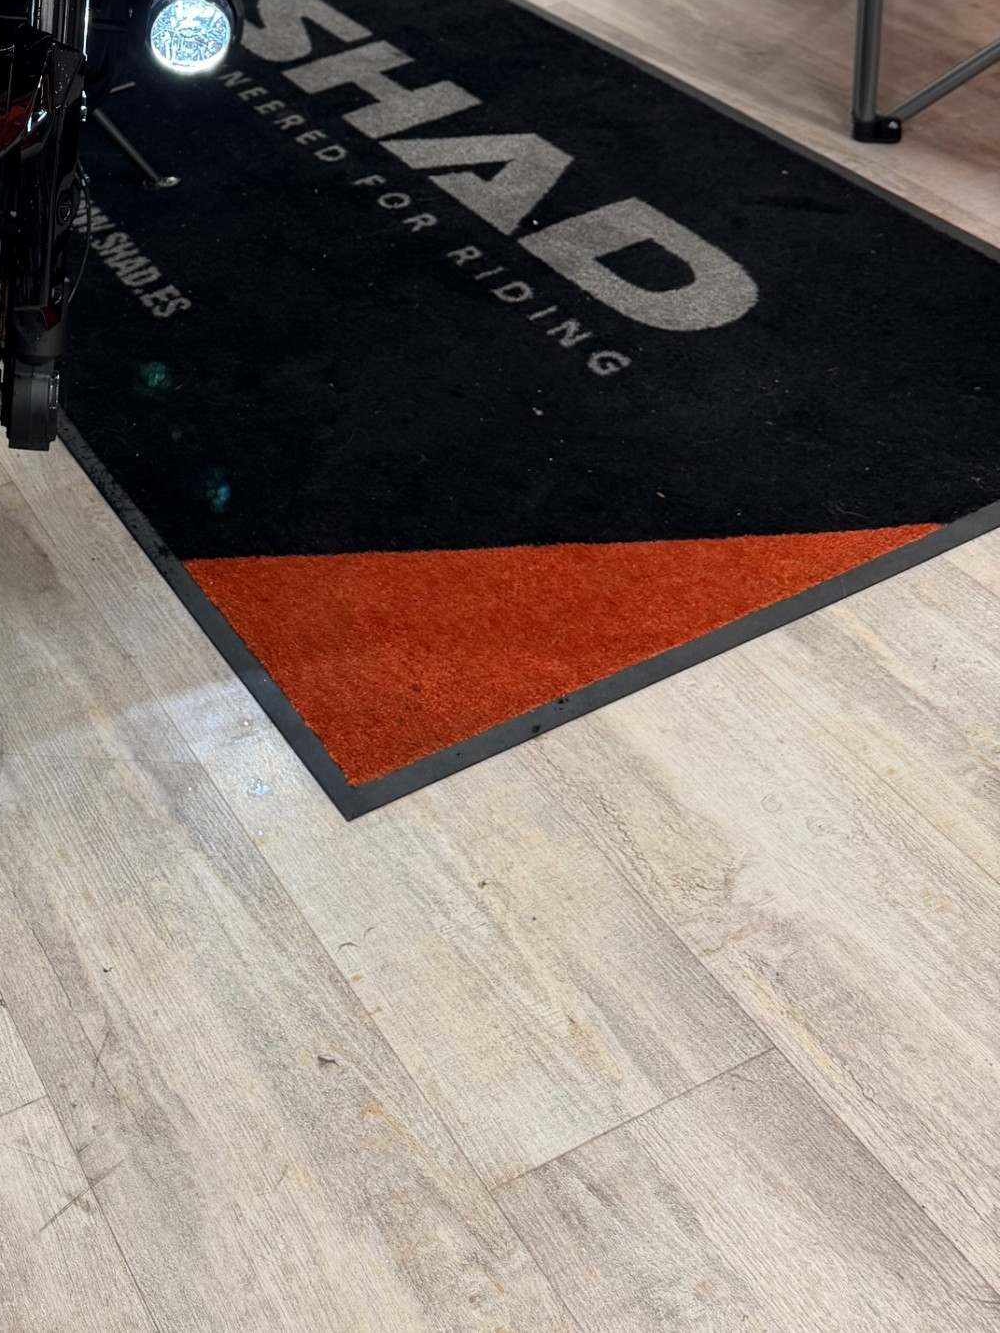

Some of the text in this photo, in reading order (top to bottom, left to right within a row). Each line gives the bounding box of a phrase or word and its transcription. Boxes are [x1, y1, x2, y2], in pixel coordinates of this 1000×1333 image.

[217, 70, 633, 376] NEERED FOR RIDING
